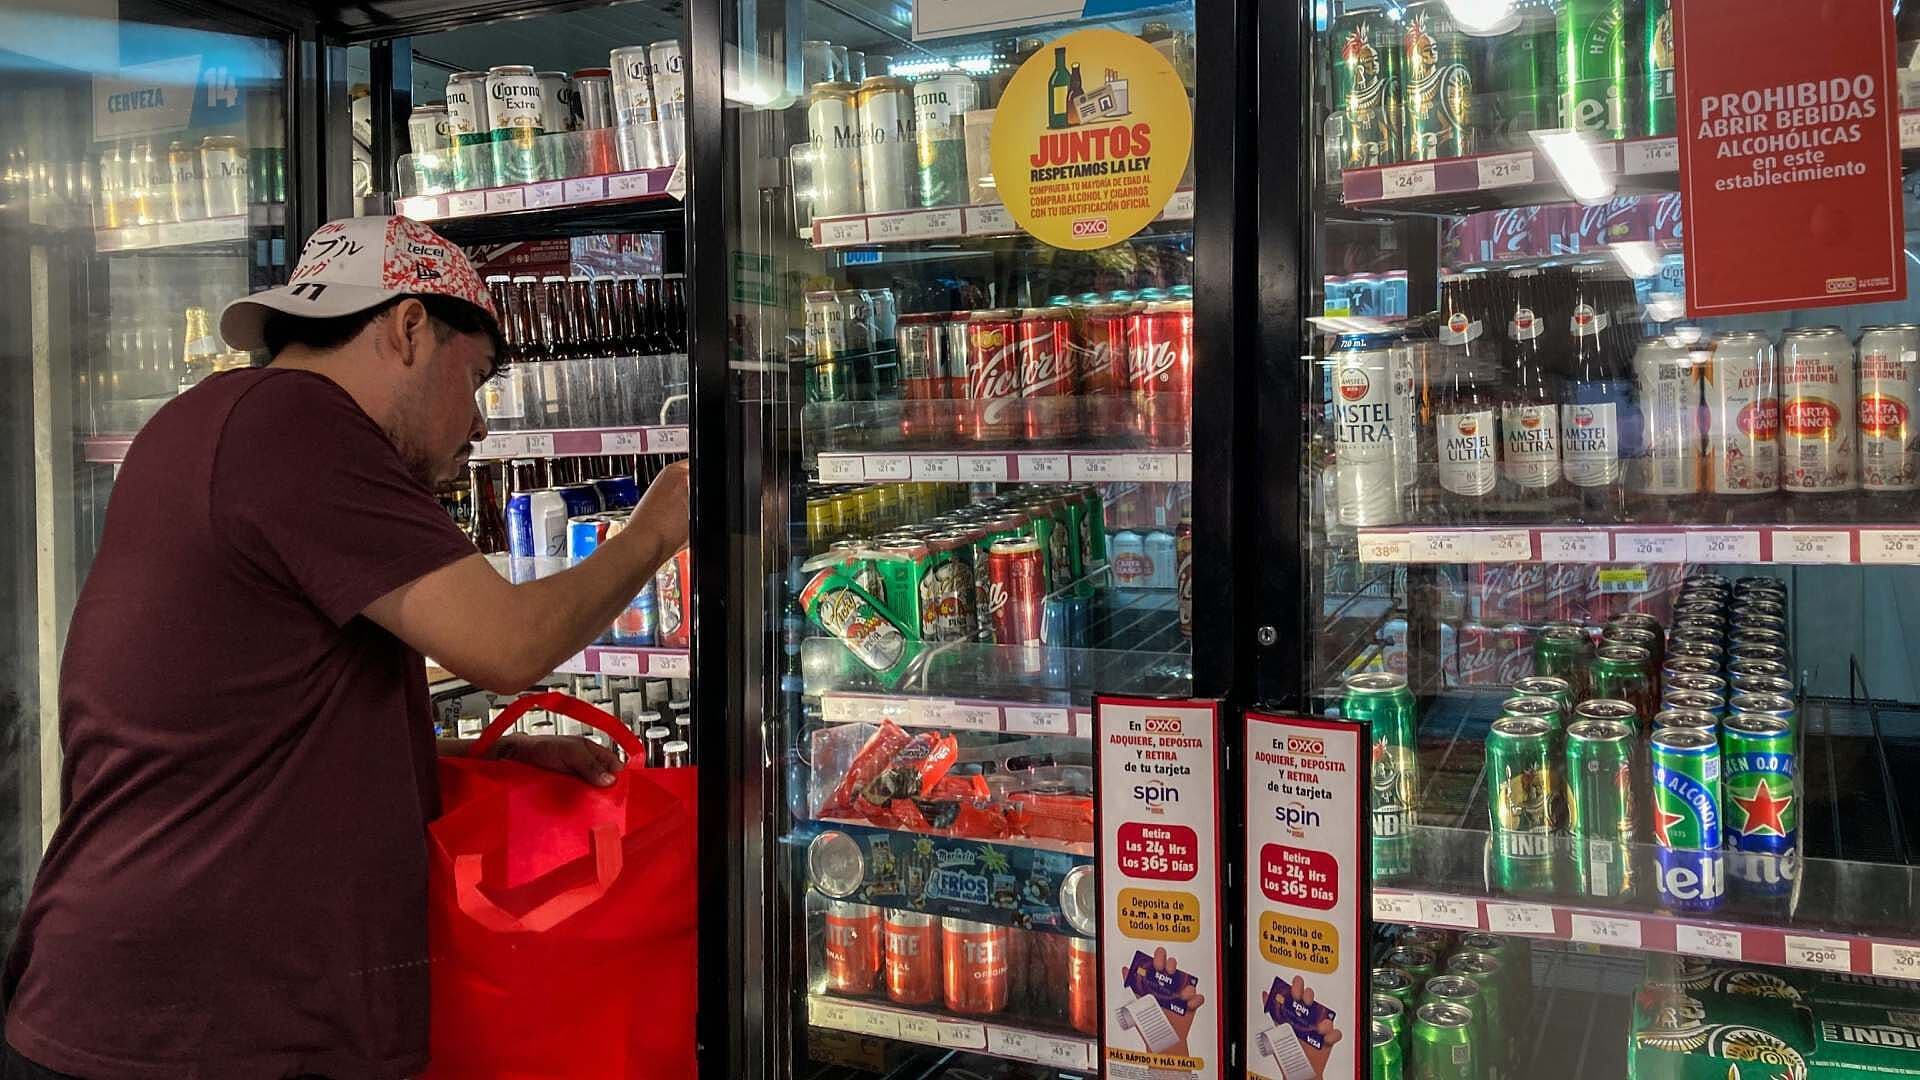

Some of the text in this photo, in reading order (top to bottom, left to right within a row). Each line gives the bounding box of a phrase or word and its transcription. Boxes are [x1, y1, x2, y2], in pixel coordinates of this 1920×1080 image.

[204, 67, 238, 108] 14
[491, 82, 540, 102] Corona
[107, 88, 164, 113] CERVEZA
[506, 99, 535, 110] Extra
[1701, 74, 1875, 121] PROHIBIDO
[1697, 99, 1876, 140] ABRIR BEBIDAS
[1030, 123, 1151, 168] JUNTOS
[1717, 124, 1861, 160] ALCOHÓLICAS
[1752, 149, 1825, 170] en este
[1030, 157, 1151, 182] RESPETAMOS LA LEY
[1715, 160, 1866, 191] establecimiento
[1029, 174, 1151, 195] COMPRUEBA TU MAYORÍA DE EDAD AL
[1030, 186, 1149, 207] COMPRAR ALCOHOL Y CIGARROS
[1030, 199, 1150, 219] CON TU IDENTIFICACIÓN OFICIAL
[1073, 220, 1107, 234] OXXO
[408, 242, 444, 258] telcel
[291, 283, 328, 301] 11
[1509, 428, 1554, 442] AMSTEL
[1512, 441, 1553, 452] ULTRA
[1566, 439, 1606, 451] ULTRA
[1129, 720, 1141, 732] En
[1110, 734, 1203, 748] ADQUIERE, DEPOSITA
[1272, 738, 1284, 750] En
[1136, 750, 1177, 761] Y RETIRA
[1255, 751, 1346, 772] ADQUIERE, DEPOSITA
[1124, 762, 1190, 777] de tu tarjeta
[1279, 769, 1319, 784] Y RETIRA
[1133, 782, 1179, 805] spin
[1267, 781, 1332, 800] de tu tarjeta
[1275, 804, 1320, 827] spin
[1142, 828, 1171, 839] Retira
[1126, 840, 1186, 856] Las 24 Hrs
[1123, 855, 1194, 873] Los 365 Días
[1283, 851, 1311, 865] Retira
[1267, 861, 1327, 882] Las 24 Hrs
[1264, 878, 1334, 901] Los 365 Días
[1132, 897, 1184, 910] Deposita de
[1122, 908, 1127, 917] 6
[1130, 911, 1150, 919] a.m.
[1161, 912, 1171, 920] 10
[1173, 913, 1195, 923] p.m.
[1129, 919, 1191, 934] todos los días
[1272, 921, 1322, 940] Deposita de
[1270, 934, 1289, 946] a.m.
[1291, 939, 1297, 947] a
[1299, 940, 1310, 950] 10
[1312, 942, 1334, 954] p.m.
[1269, 944, 1329, 965] todos los días
[1154, 971, 1173, 985] spin
[1170, 1003, 1185, 1015] VISA
[1292, 1001, 1309, 1016] spin
[1306, 1036, 1321, 1049] VISA
[1109, 1049, 1124, 1060] MÁS
[1125, 1051, 1151, 1064] RÁPIDO
[1160, 1055, 1175, 1067] MÁS
[1177, 1056, 1196, 1069] FÁCIL
